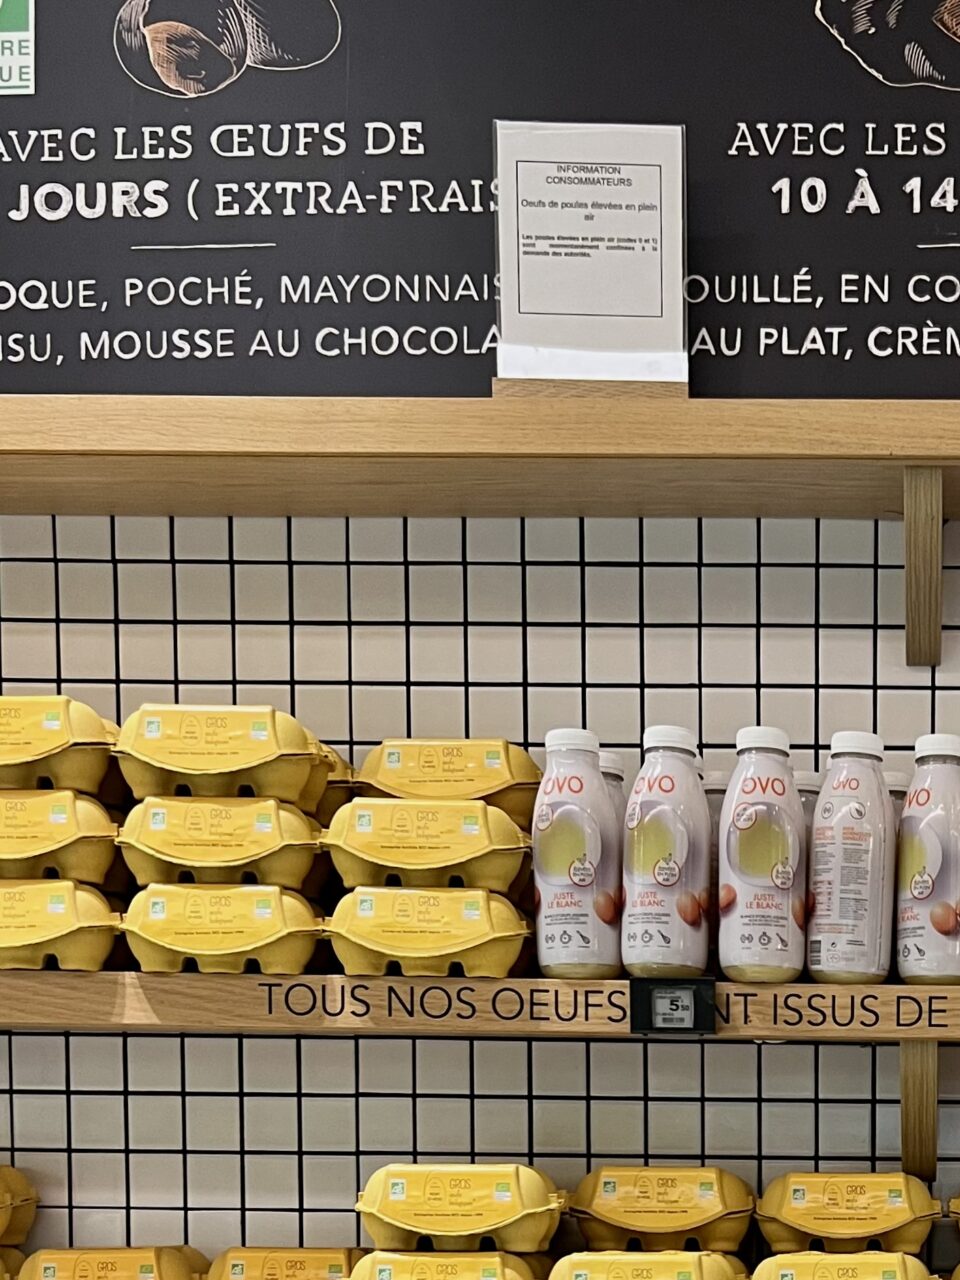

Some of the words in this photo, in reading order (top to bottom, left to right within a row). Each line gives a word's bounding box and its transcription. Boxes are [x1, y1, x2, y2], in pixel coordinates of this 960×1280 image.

[114, 125, 192, 159] LES
[210, 122, 346, 156] ŒUFS
[365, 122, 424, 154] DE
[728, 123, 844, 155] AVEC
[865, 123, 945, 155] LES
[557, 165, 621, 174] INFORMATION
[546, 176, 632, 186] CONSOMMATEURS
[8, 180, 169, 220] JOURS
[772, 177, 826, 213] 10
[846, 168, 880, 214] À
[903, 177, 958, 213] 14
[548, 200, 559, 208] de
[125, 269, 263, 309] POCHÉ,
[841, 274, 888, 303] EN
[80, 329, 234, 360] MOUSSE
[249, 329, 299, 357] AU
[691, 327, 741, 356] AU
[760, 327, 852, 360] PLAT,
[206, 717, 227, 728] GROS
[543, 776, 583, 795] OVO
[634, 775, 675, 795] OVO
[742, 777, 785, 796] OVO
[832, 778, 860, 790] OVO
[258, 983, 370, 1017] TOUS
[388, 986, 476, 1019] NOS
[492, 988, 627, 1023] OEUFS
[773, 994, 879, 1027] ISSUS
[897, 996, 948, 1027] DE
[669, 999, 680, 1012] 5
[657, 1177, 677, 1189] GROS
[846, 1185, 866, 1196] GROS
